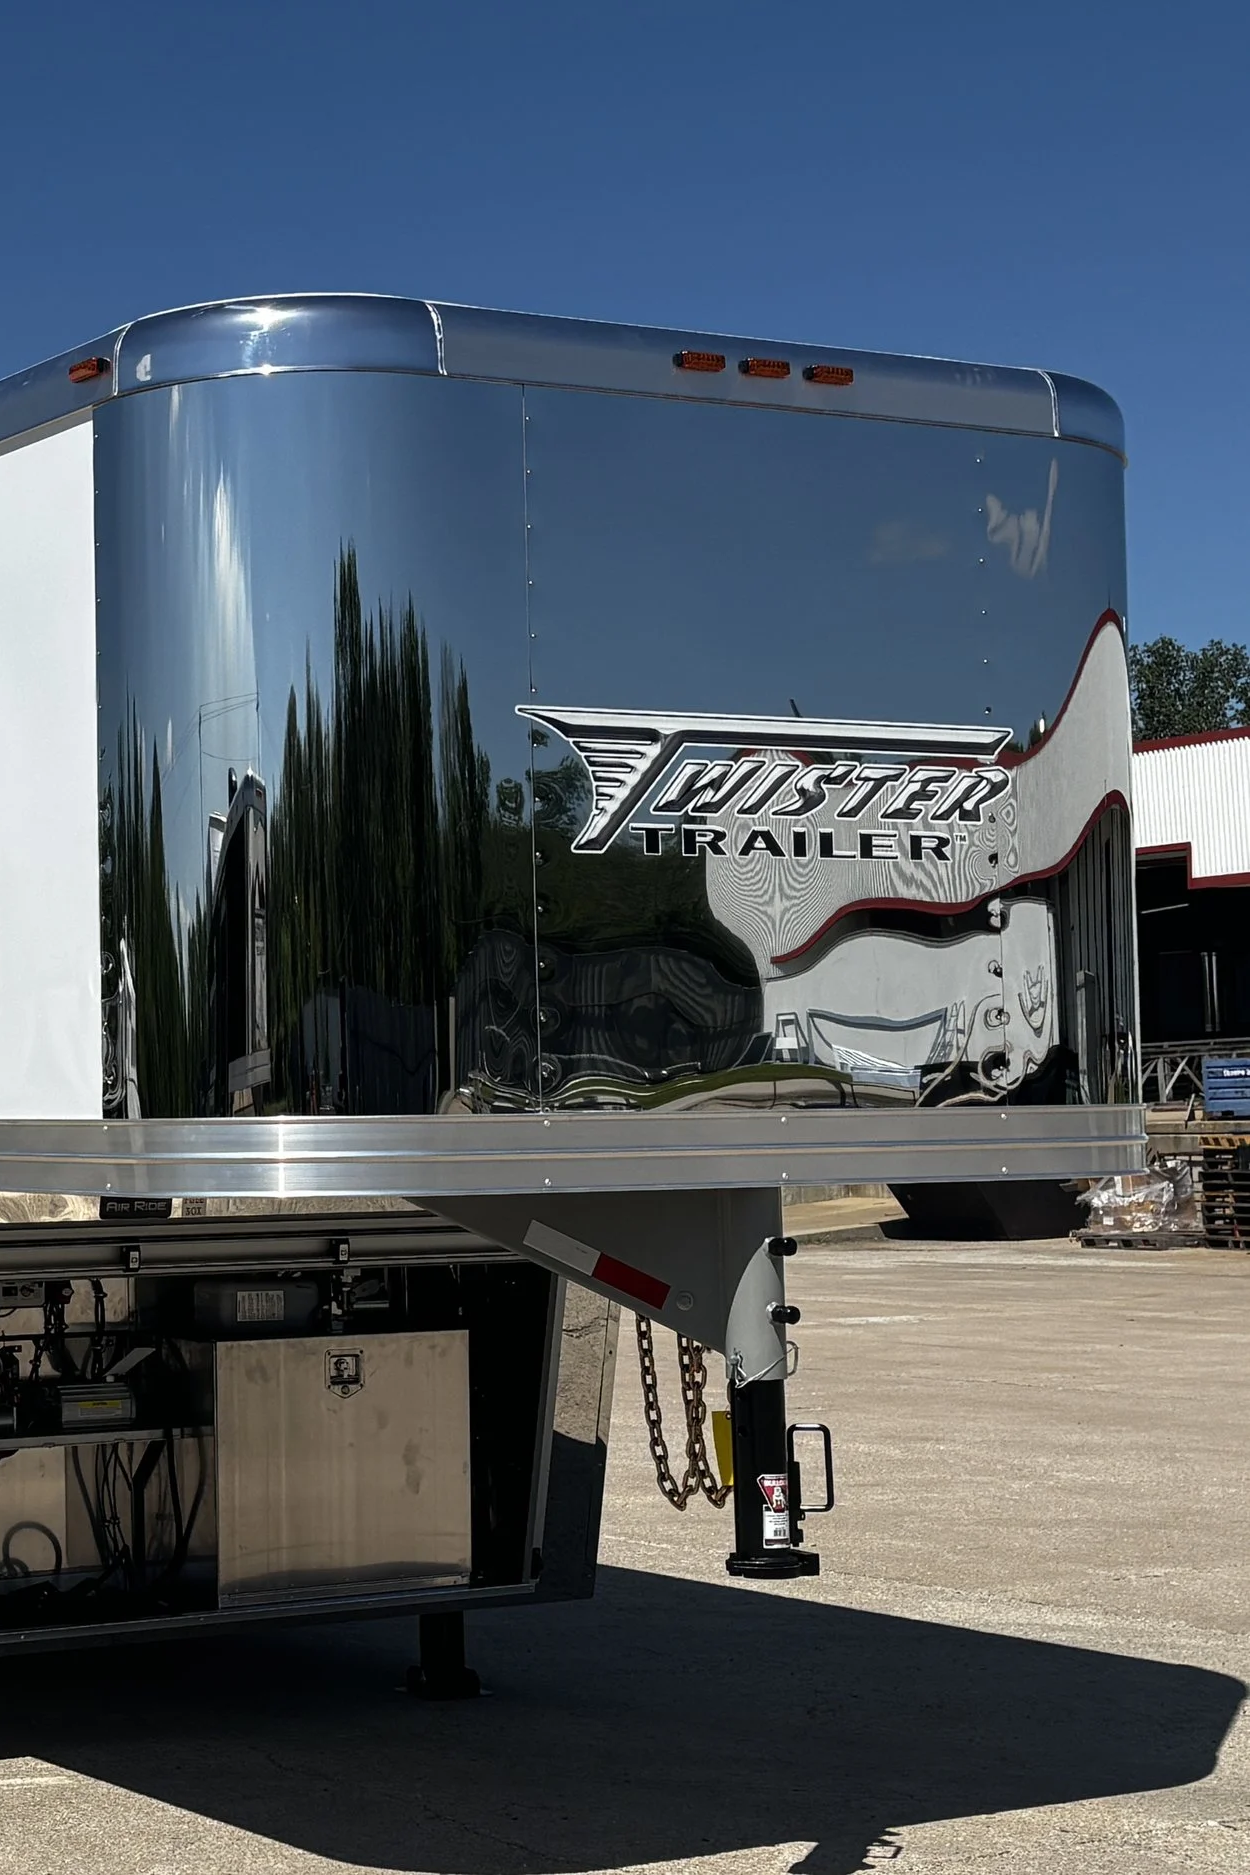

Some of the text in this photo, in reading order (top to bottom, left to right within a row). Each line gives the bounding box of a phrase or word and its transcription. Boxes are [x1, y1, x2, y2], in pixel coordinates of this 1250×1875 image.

[515, 704, 1015, 856] TWISTER
[629, 823, 953, 862] TRAILER
[106, 1201, 167, 1213] AIR RIDE
